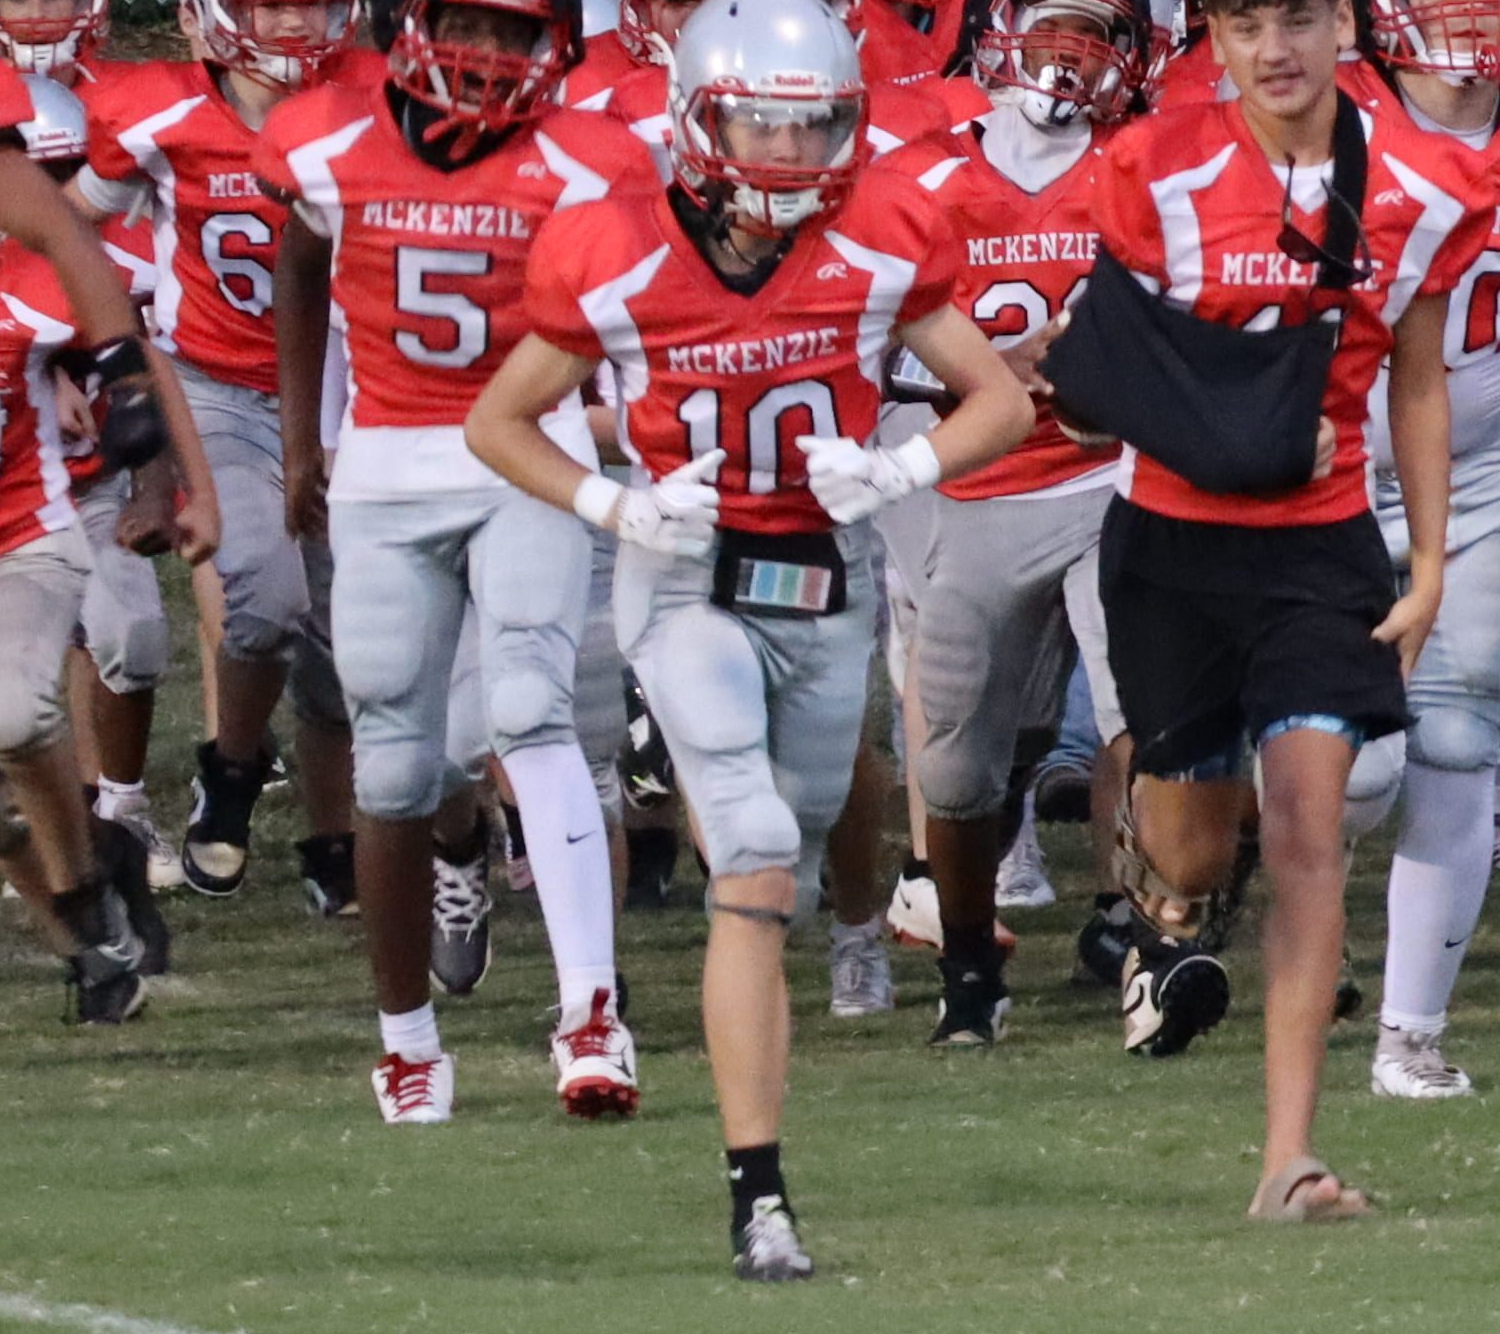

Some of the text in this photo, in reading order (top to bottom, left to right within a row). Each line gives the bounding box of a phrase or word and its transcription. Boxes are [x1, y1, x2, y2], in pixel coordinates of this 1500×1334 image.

[362, 200, 530, 239] MCKENZIE
[966, 231, 1101, 266] MCKENZIE
[394, 245, 491, 369] 5
[666, 326, 841, 375] MCKENZIE
